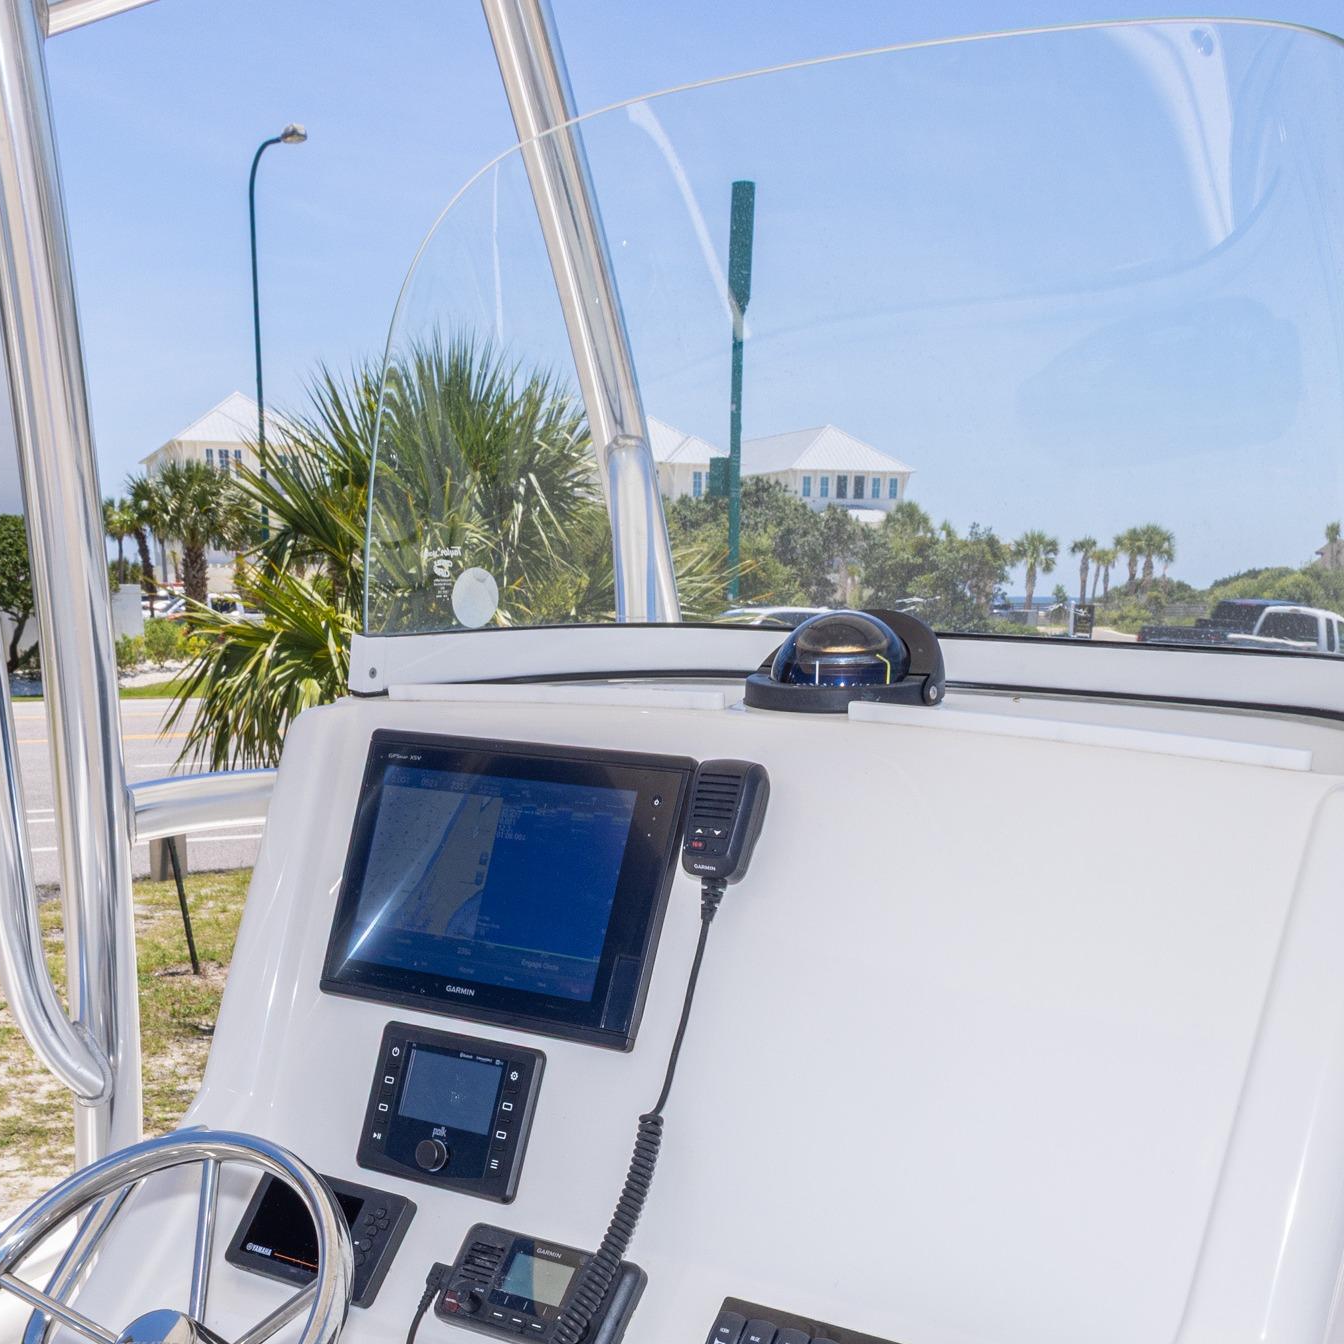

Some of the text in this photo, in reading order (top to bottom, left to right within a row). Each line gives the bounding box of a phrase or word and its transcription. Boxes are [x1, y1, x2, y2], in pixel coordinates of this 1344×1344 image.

[693, 863, 716, 871] GARMIN
[445, 984, 475, 997] GARMIN
[432, 1126, 447, 1138] polk
[252, 1244, 272, 1257] YAMAHA
[536, 1247, 562, 1259] GARMIN
